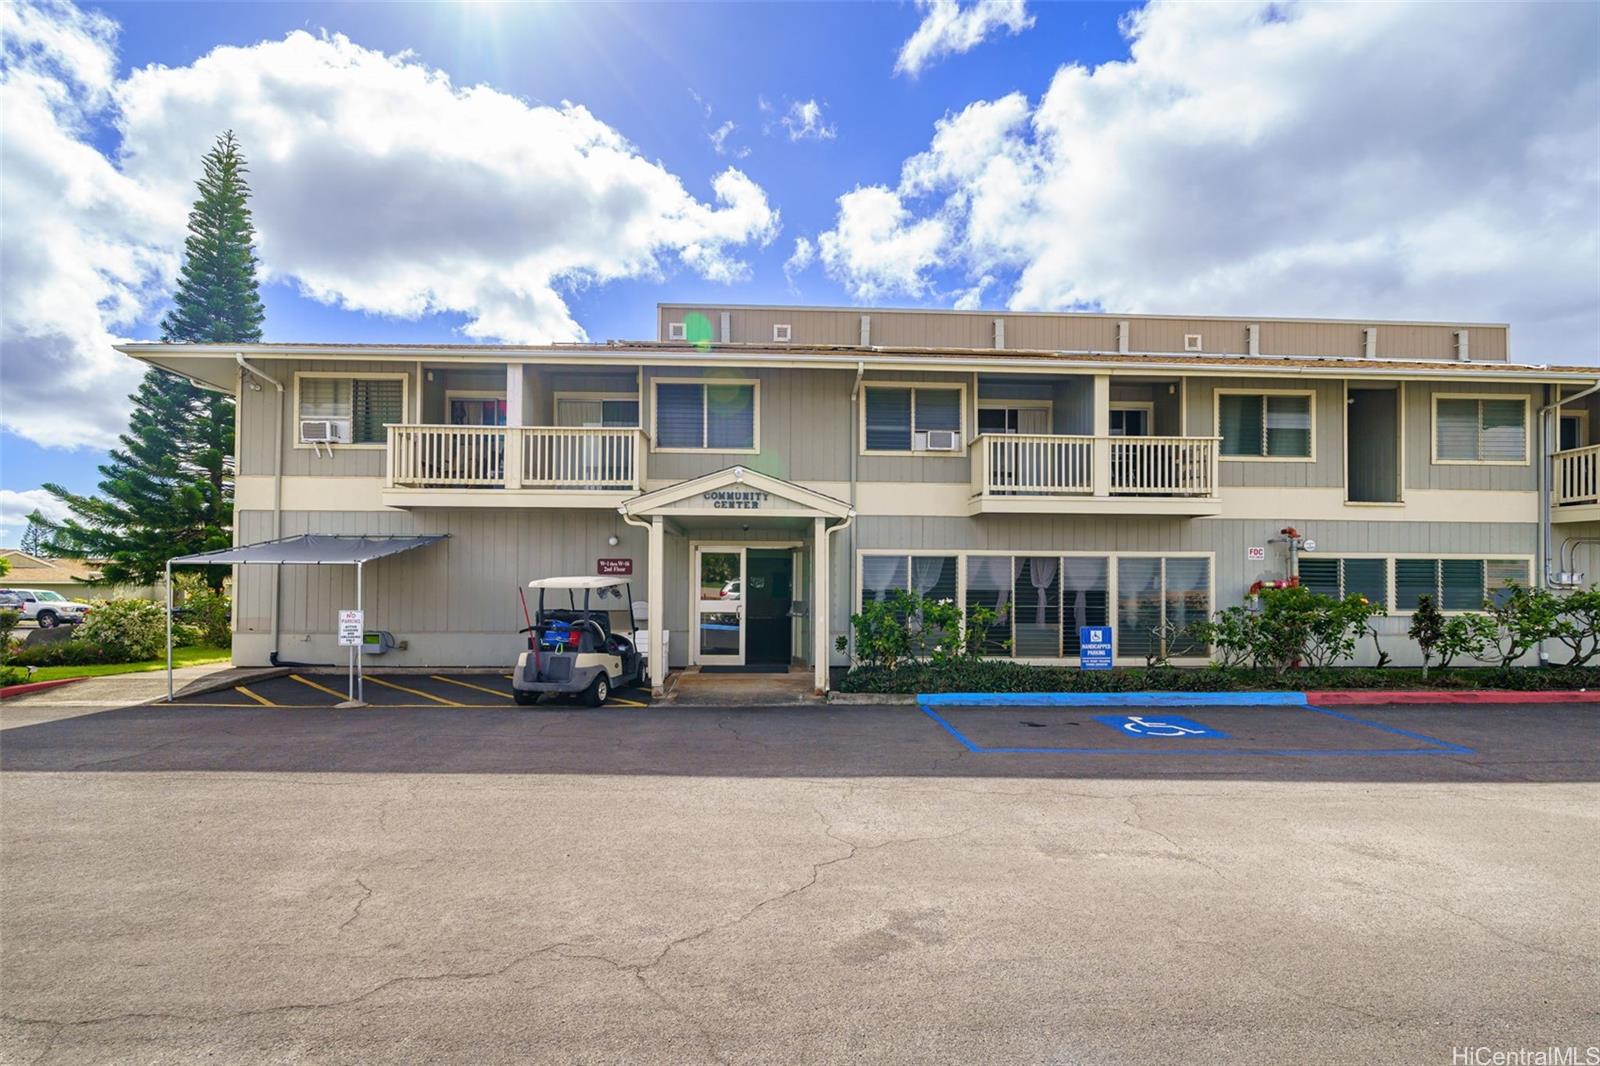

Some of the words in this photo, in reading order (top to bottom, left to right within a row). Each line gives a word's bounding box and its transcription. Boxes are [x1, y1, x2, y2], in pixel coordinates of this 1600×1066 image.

[703, 491, 769, 501] COMMUNITY
[713, 501, 759, 509] CENTER
[1249, 548, 1263, 556] FDC
